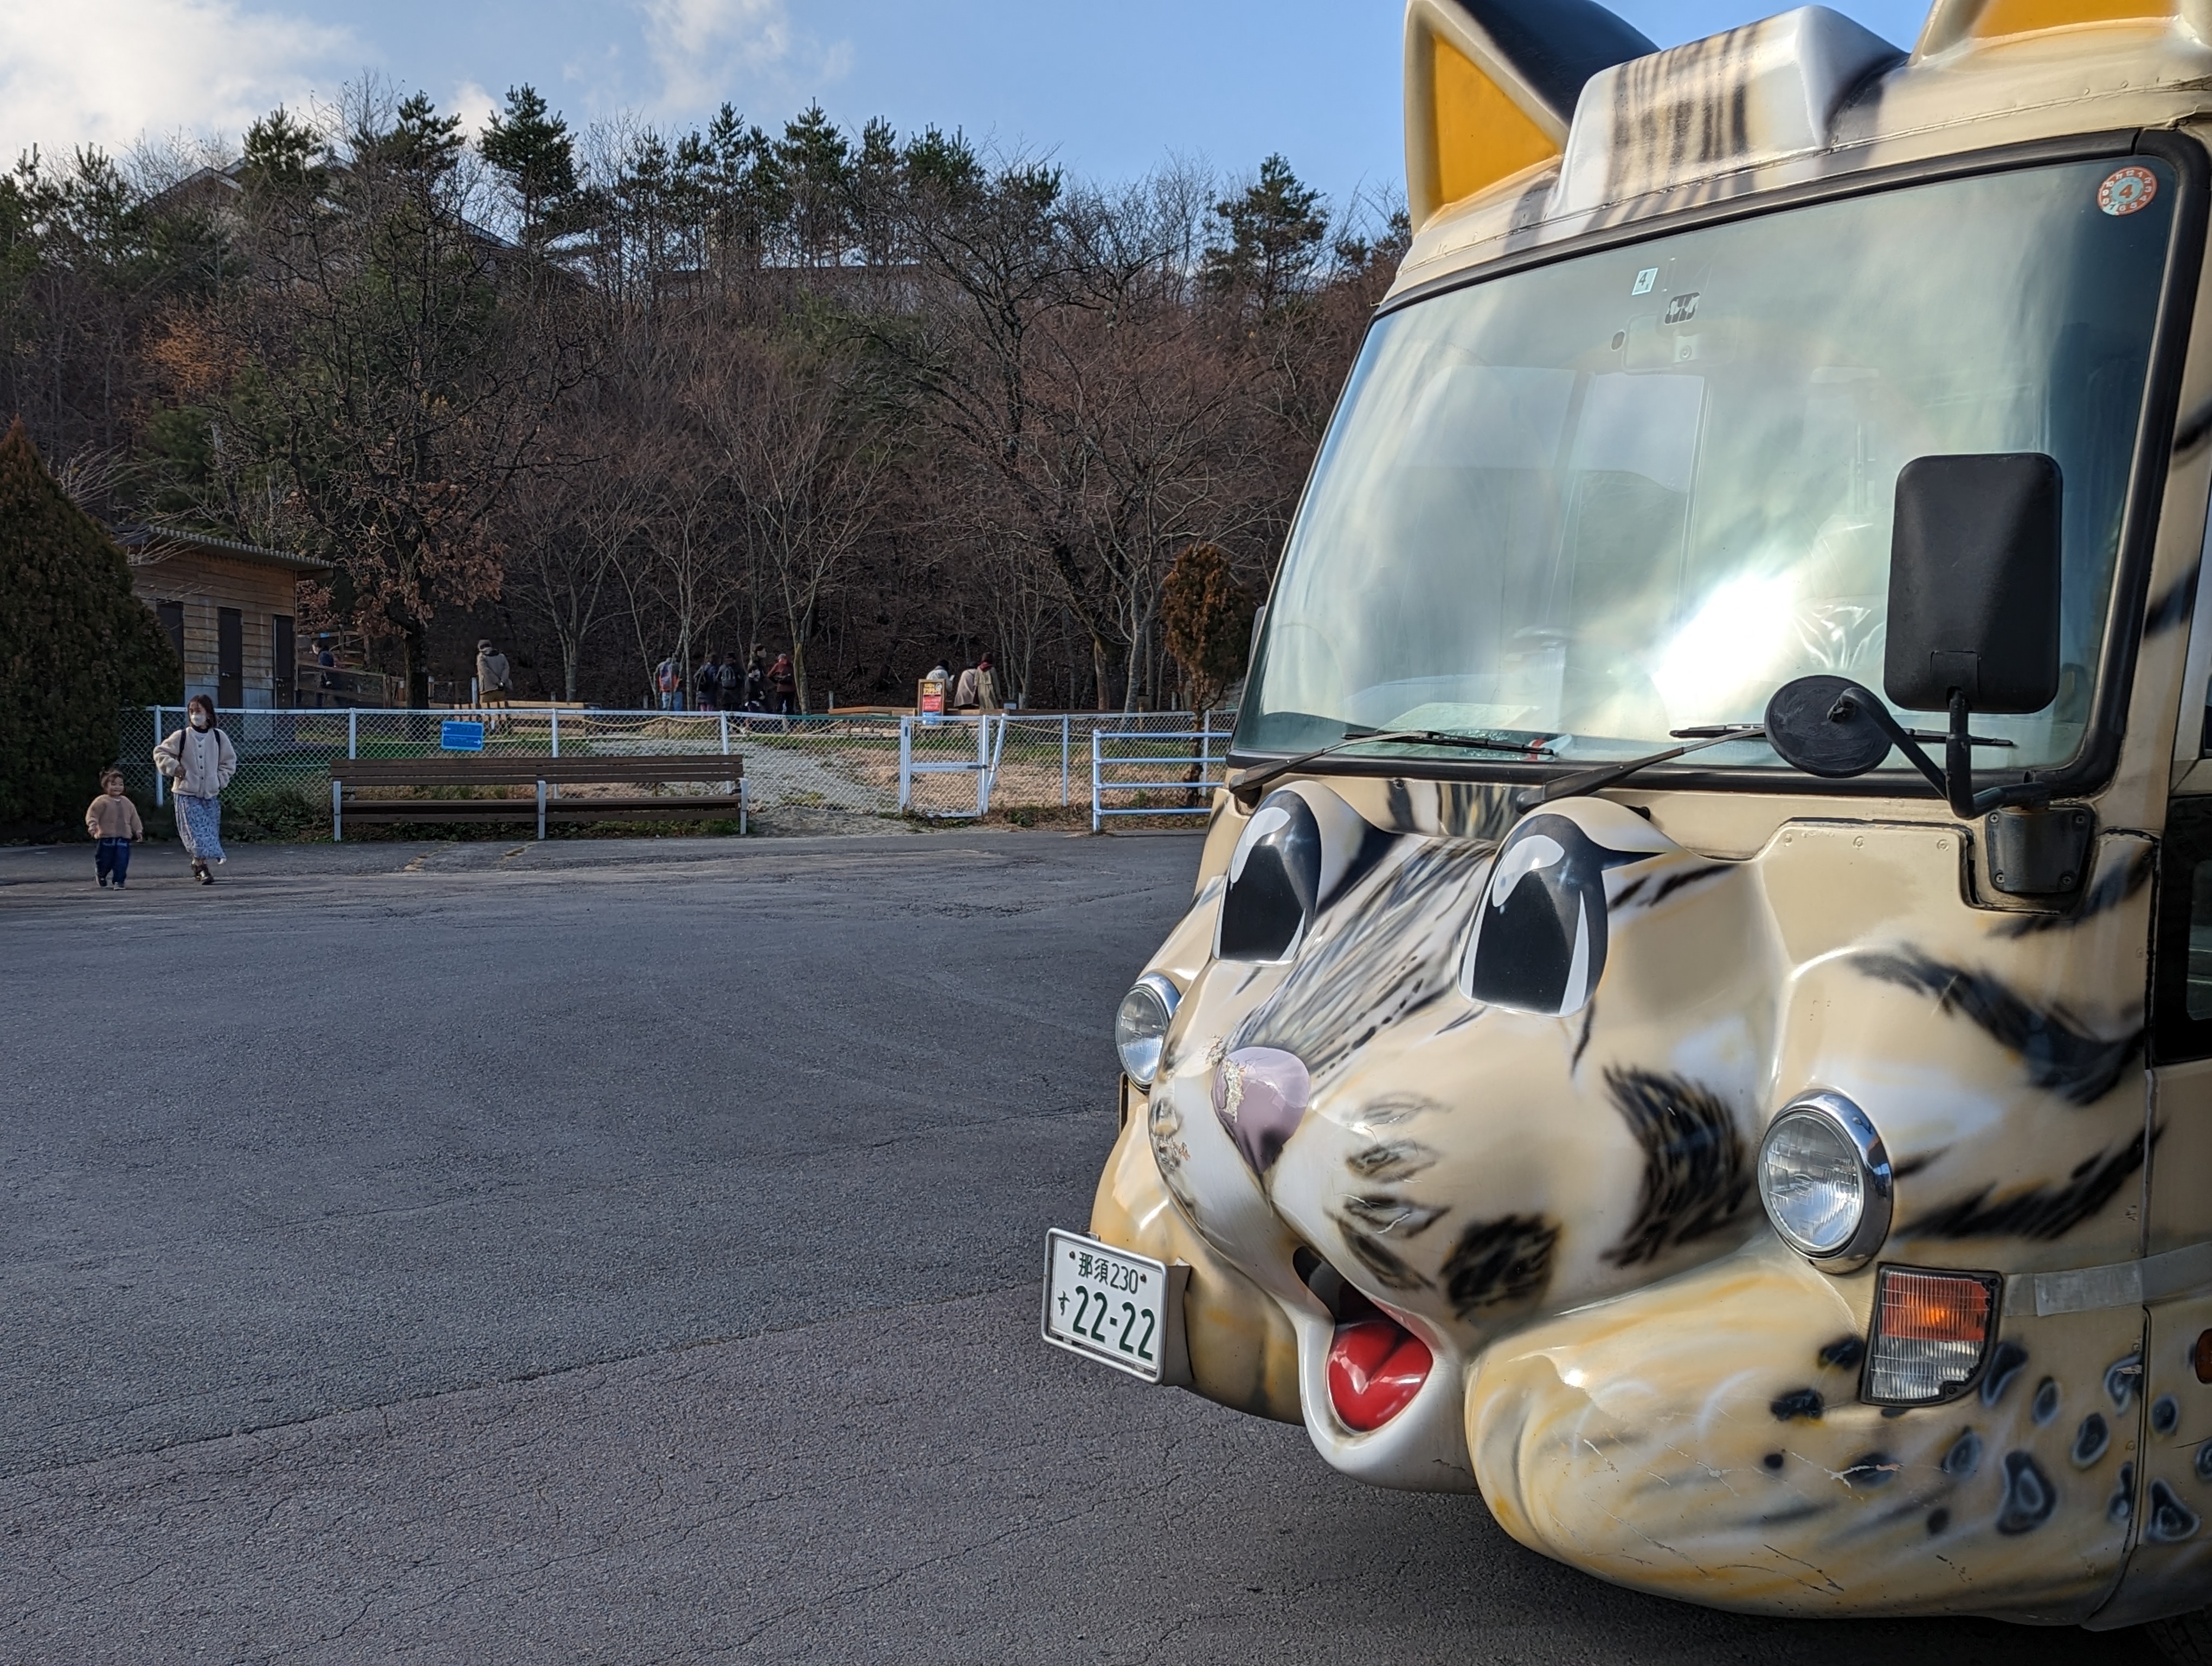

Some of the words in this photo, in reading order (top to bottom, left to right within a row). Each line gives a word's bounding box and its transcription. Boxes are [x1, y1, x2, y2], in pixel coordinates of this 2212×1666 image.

[2119, 184, 2133, 198] 4
[1639, 272, 1648, 286] 4
[1078, 1251, 1138, 1295] 那須230
[1057, 1290, 1070, 1316] す
